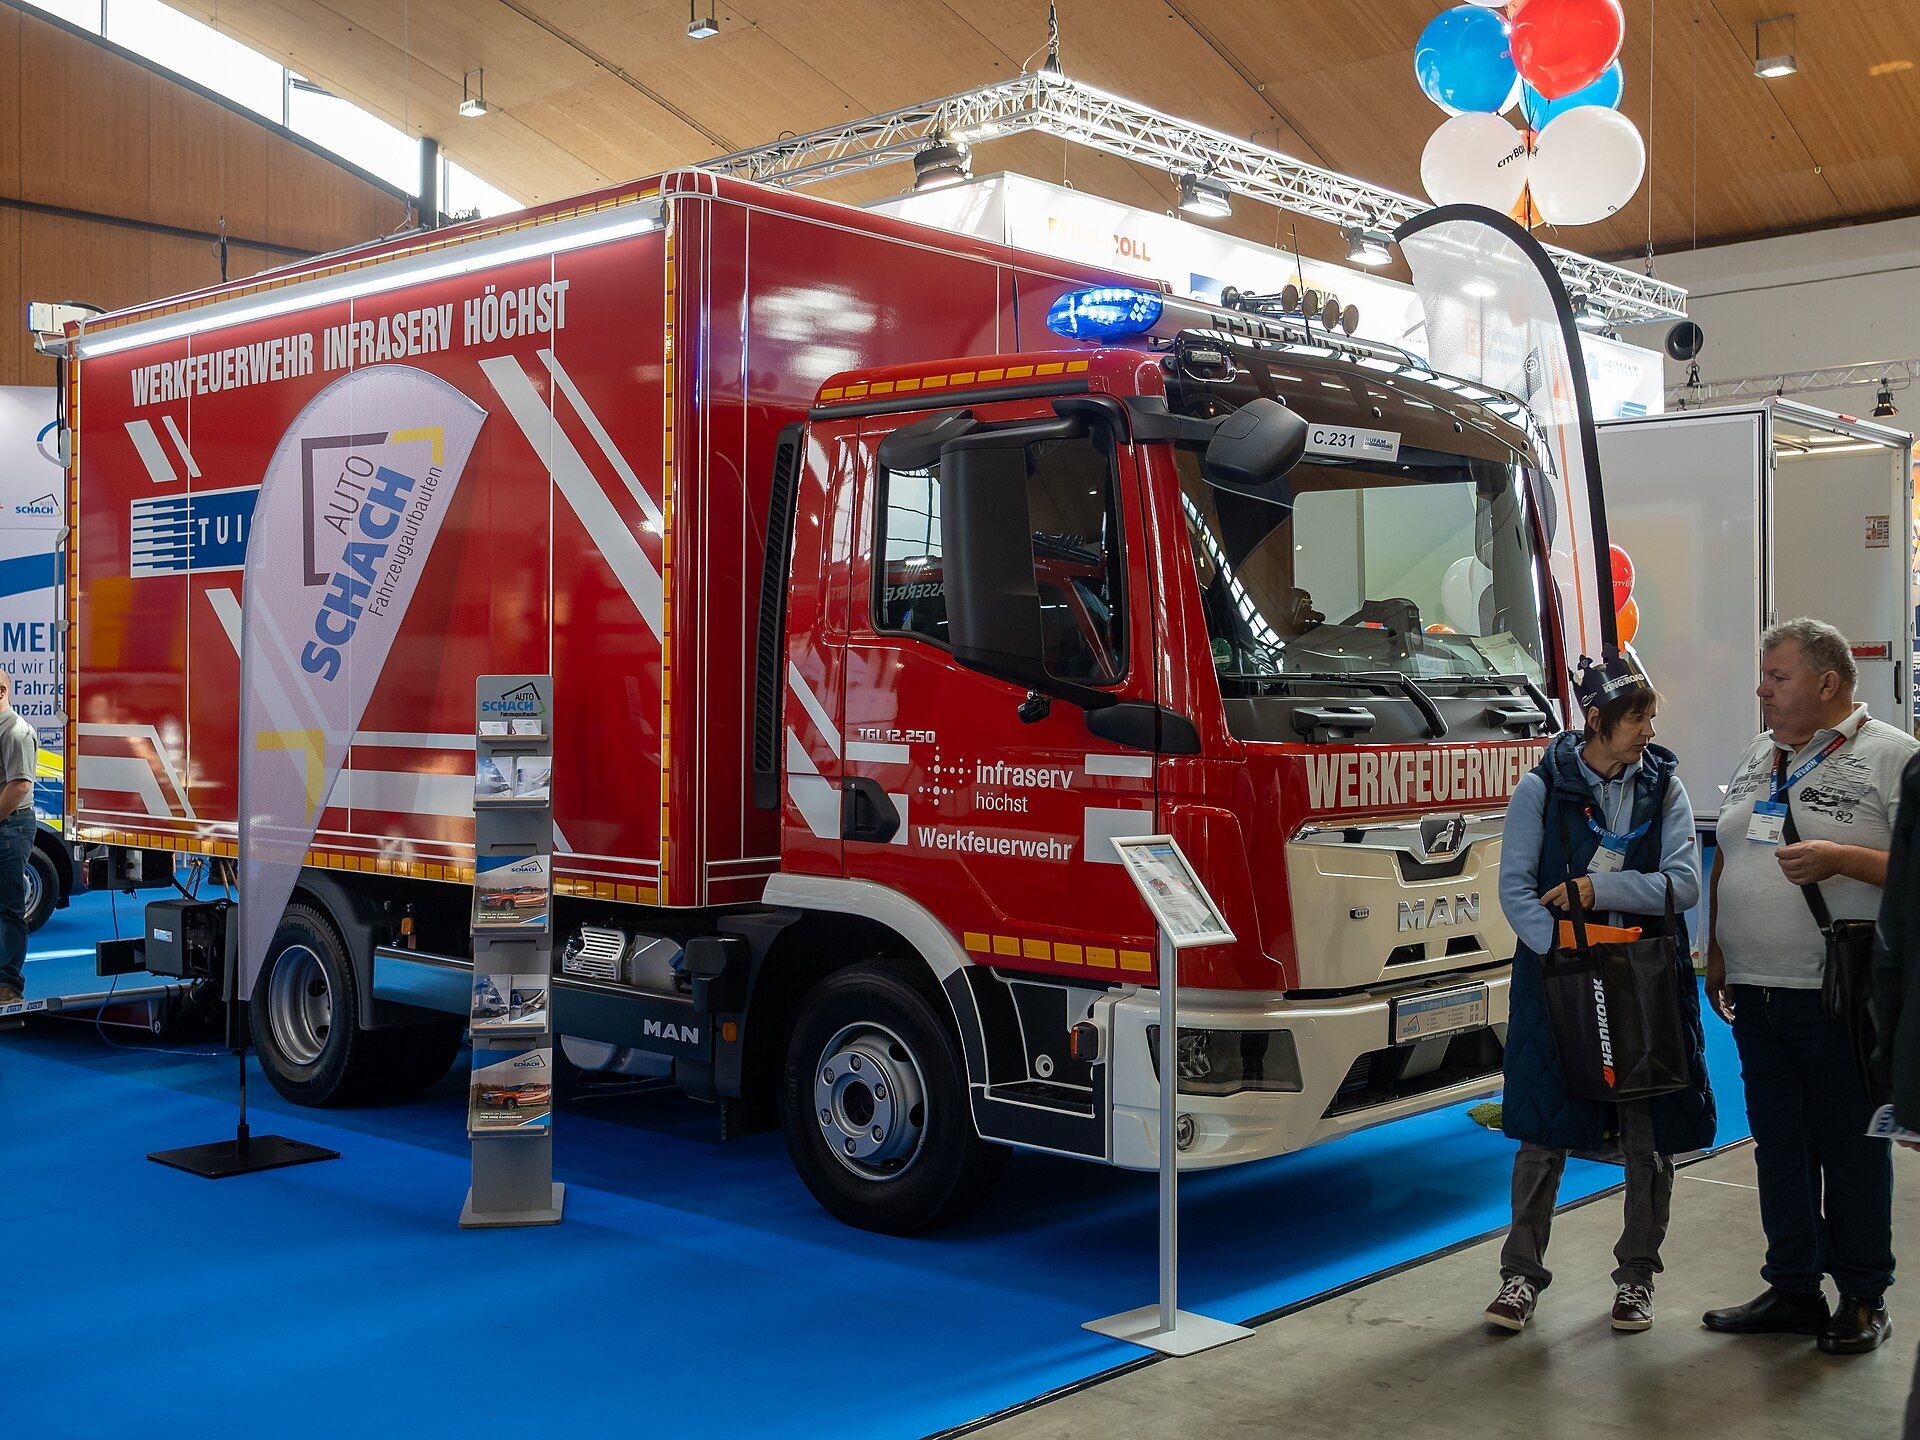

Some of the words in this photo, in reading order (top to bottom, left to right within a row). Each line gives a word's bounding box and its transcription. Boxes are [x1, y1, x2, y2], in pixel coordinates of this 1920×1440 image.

[131, 334, 314, 407] WERKFEUERWEHR
[323, 303, 453, 367] INFRASERV
[464, 280, 570, 346] HÖCHST
[1314, 431, 1355, 448] C.231
[318, 455, 375, 536] AUTO
[15, 506, 54, 514] SCHACH
[198, 514, 246, 545] TUI
[368, 465, 444, 618] Fahrzeugaufbauten
[301, 465, 416, 682] SCHACH
[22, 658, 44, 674] wir
[481, 700, 534, 712] SCHACH
[515, 692, 534, 701] AUTO
[858, 728, 883, 742] TGL
[885, 729, 936, 743] 12.250
[976, 759, 1074, 790] infraserv
[976, 792, 1028, 813] höchst
[1835, 810, 1853, 824] 82
[918, 826, 1072, 861] Werkfeuerwehr
[1398, 892, 1480, 933] MAN
[643, 1019, 699, 1045] MAN
